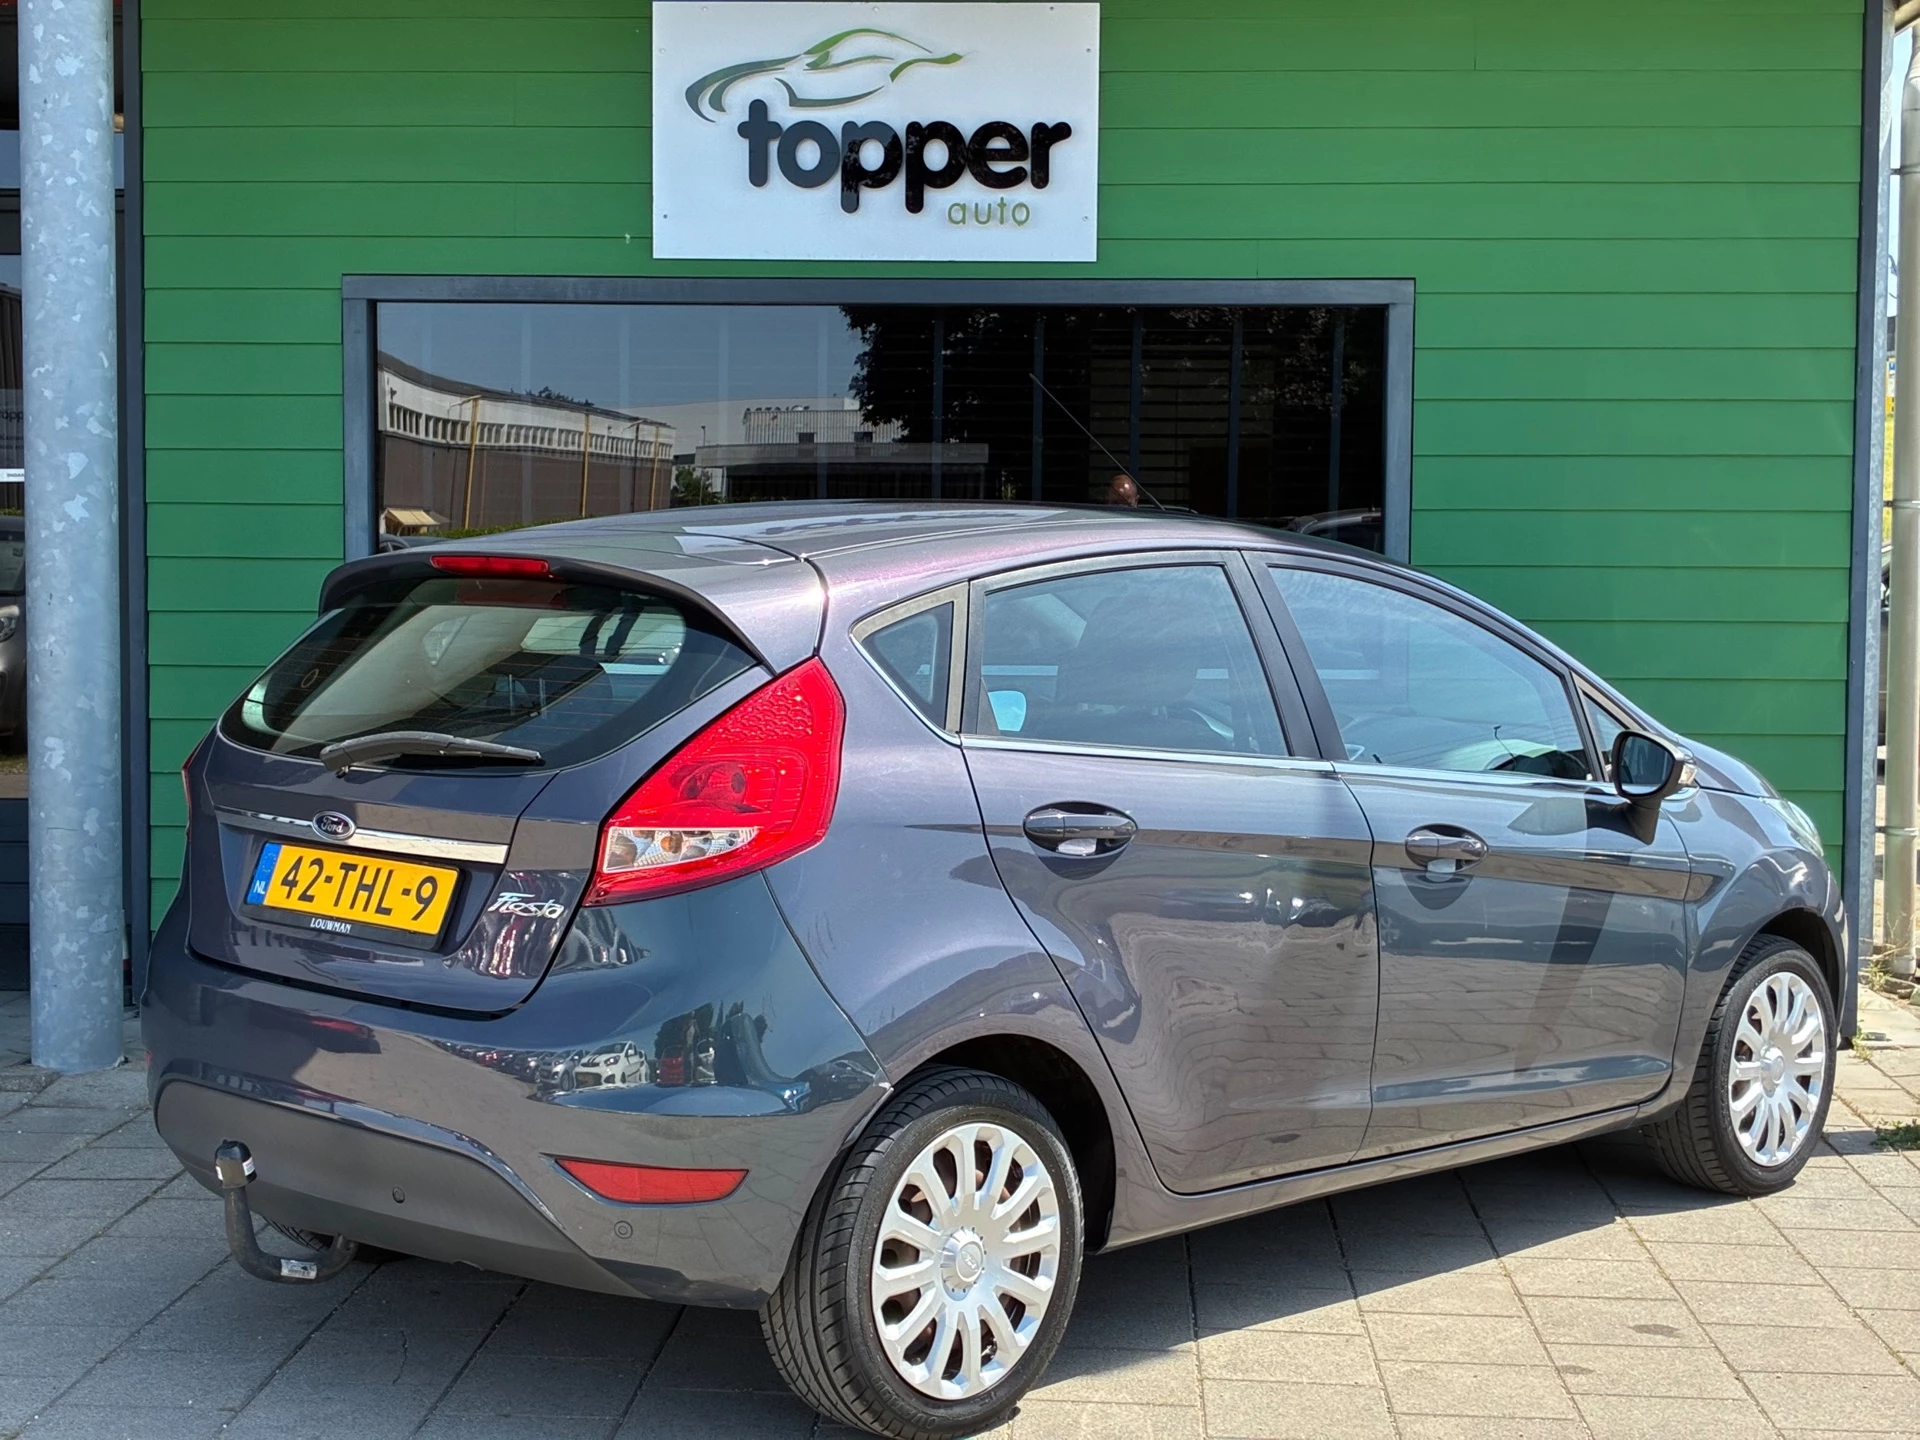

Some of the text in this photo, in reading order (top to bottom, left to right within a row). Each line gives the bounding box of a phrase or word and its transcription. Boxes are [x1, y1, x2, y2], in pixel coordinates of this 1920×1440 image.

[737, 99, 1073, 214] topper
[947, 197, 1031, 227] auto
[320, 815, 344, 833] Ford
[253, 880, 266, 895] NL
[280, 855, 438, 922] 42-THL-9
[487, 891, 565, 919] Fiesta
[310, 918, 352, 934] LOUWMAN
